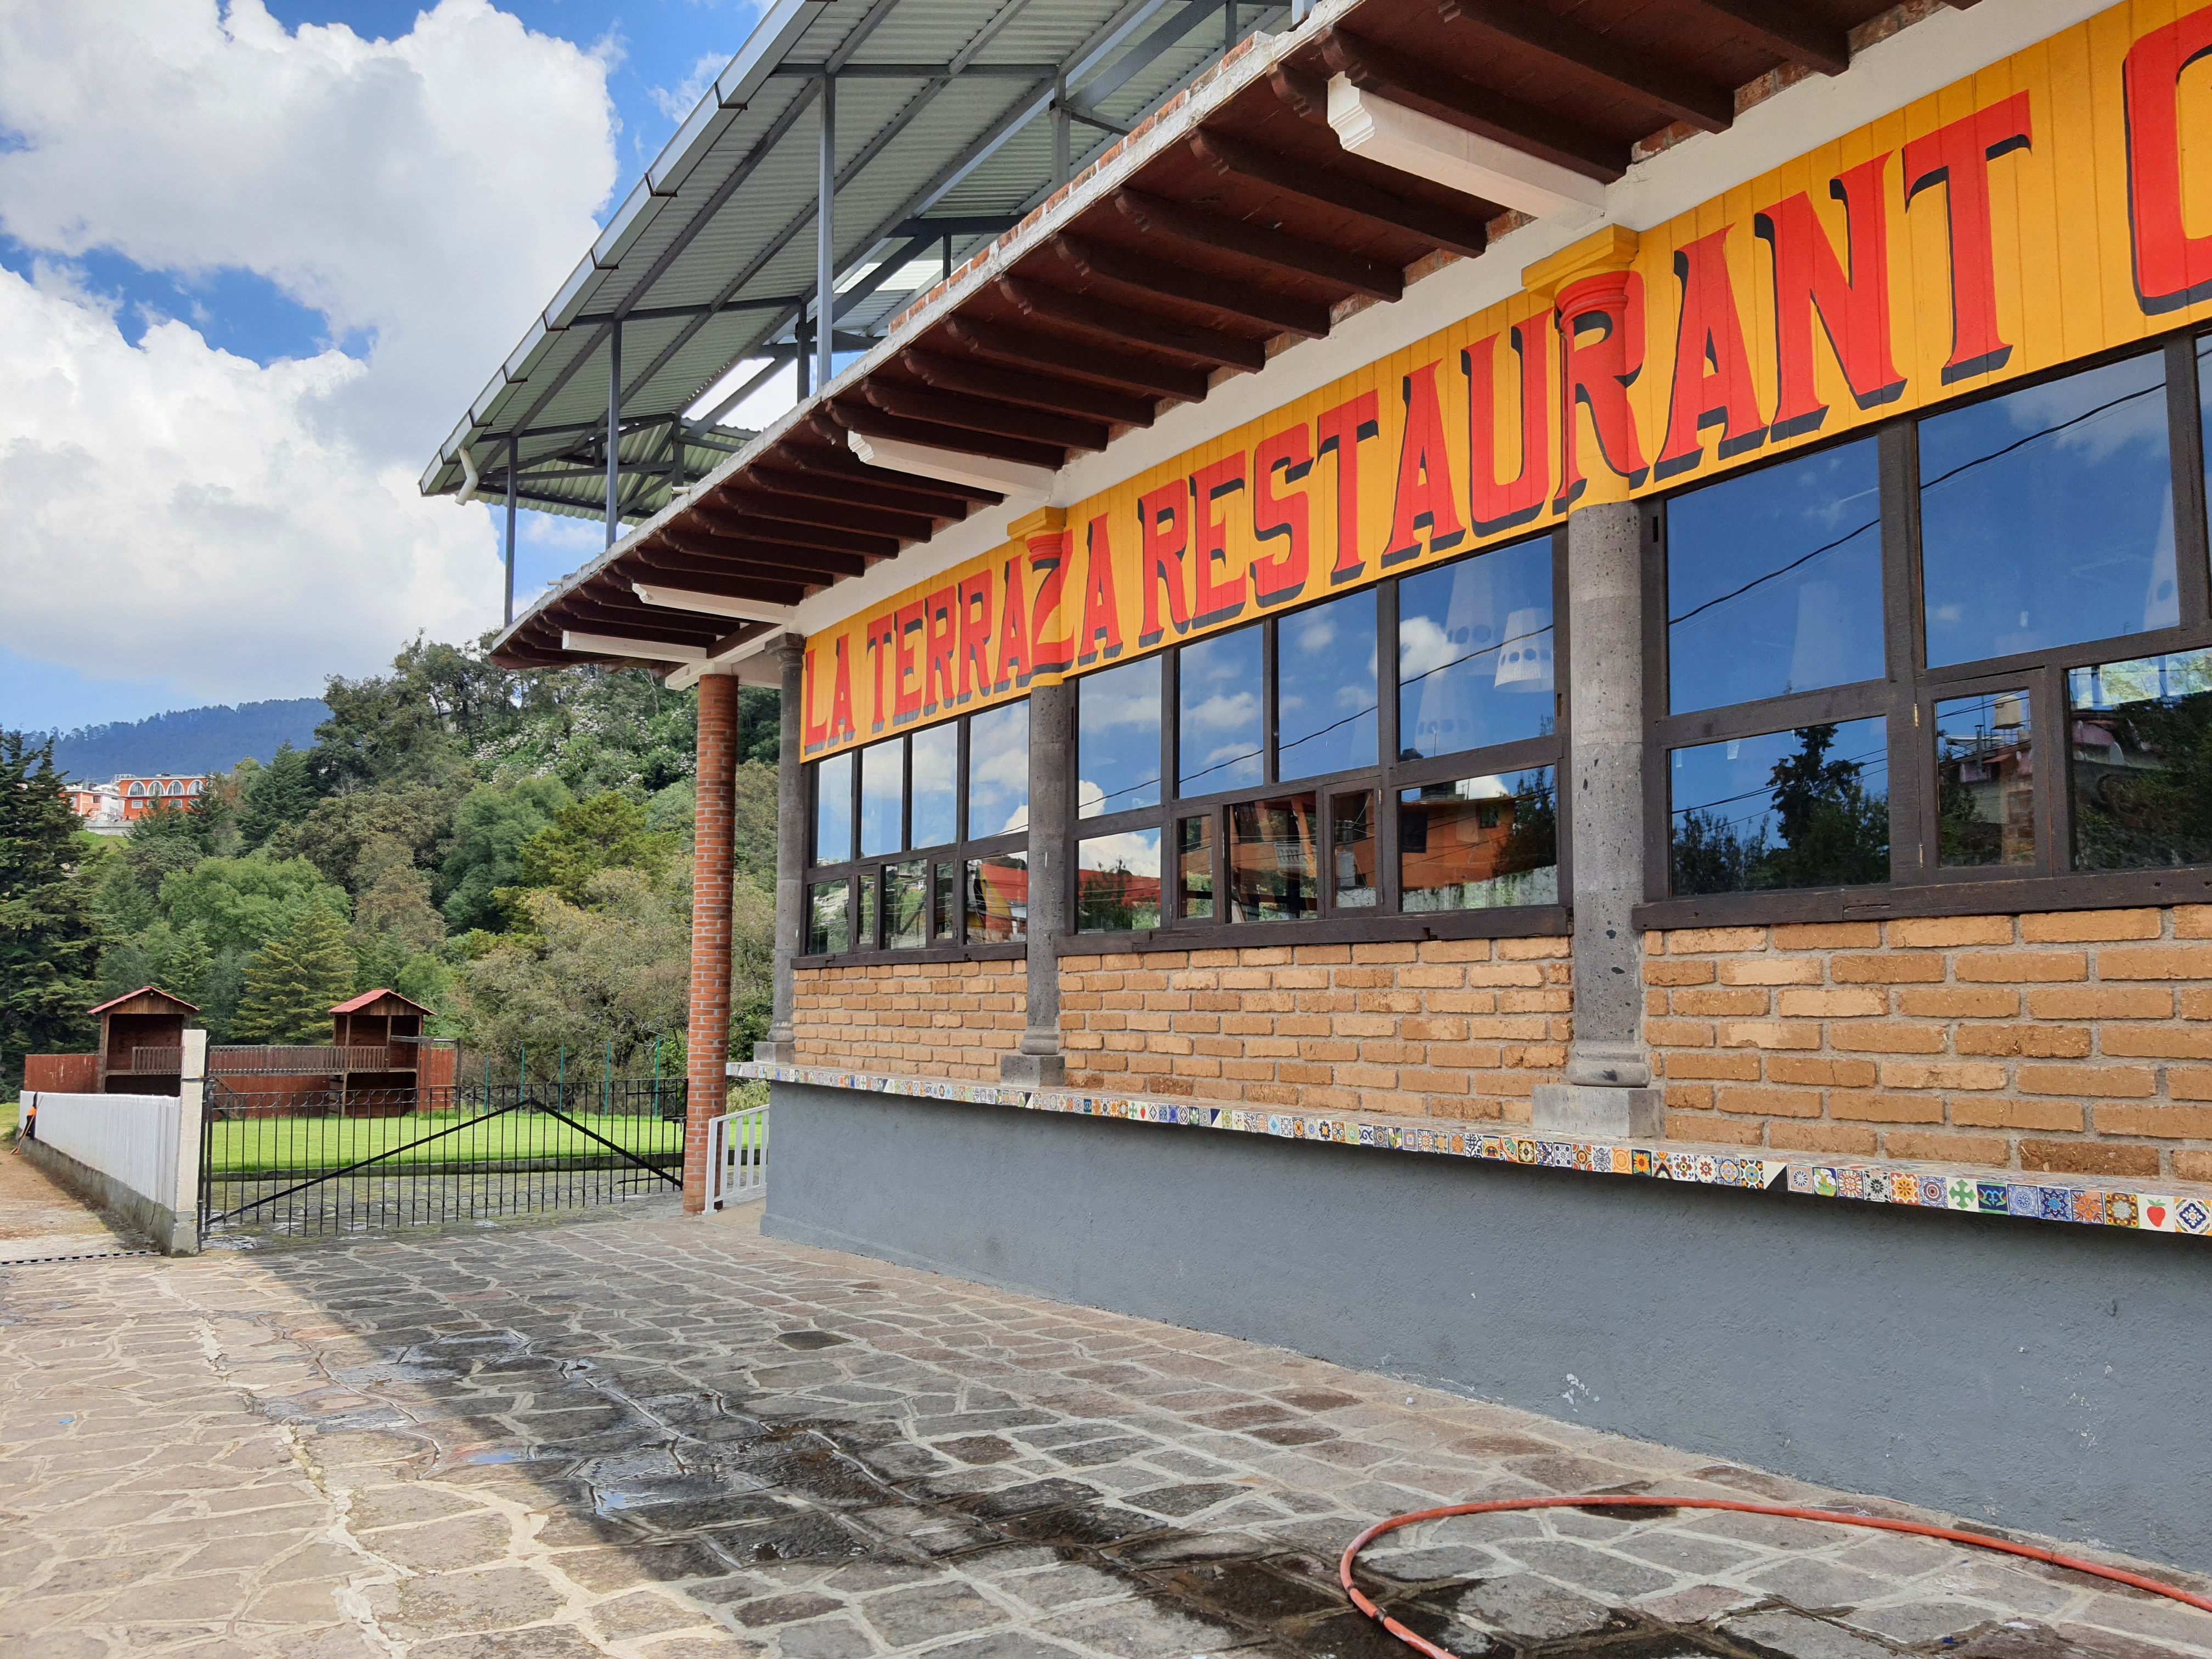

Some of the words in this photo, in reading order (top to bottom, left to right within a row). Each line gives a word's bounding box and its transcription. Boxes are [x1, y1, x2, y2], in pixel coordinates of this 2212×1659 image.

[804, 633, 856, 756] LA
[866, 512, 1124, 734] TERRAZA
[1137, 89, 2033, 648] RESTAURANT
